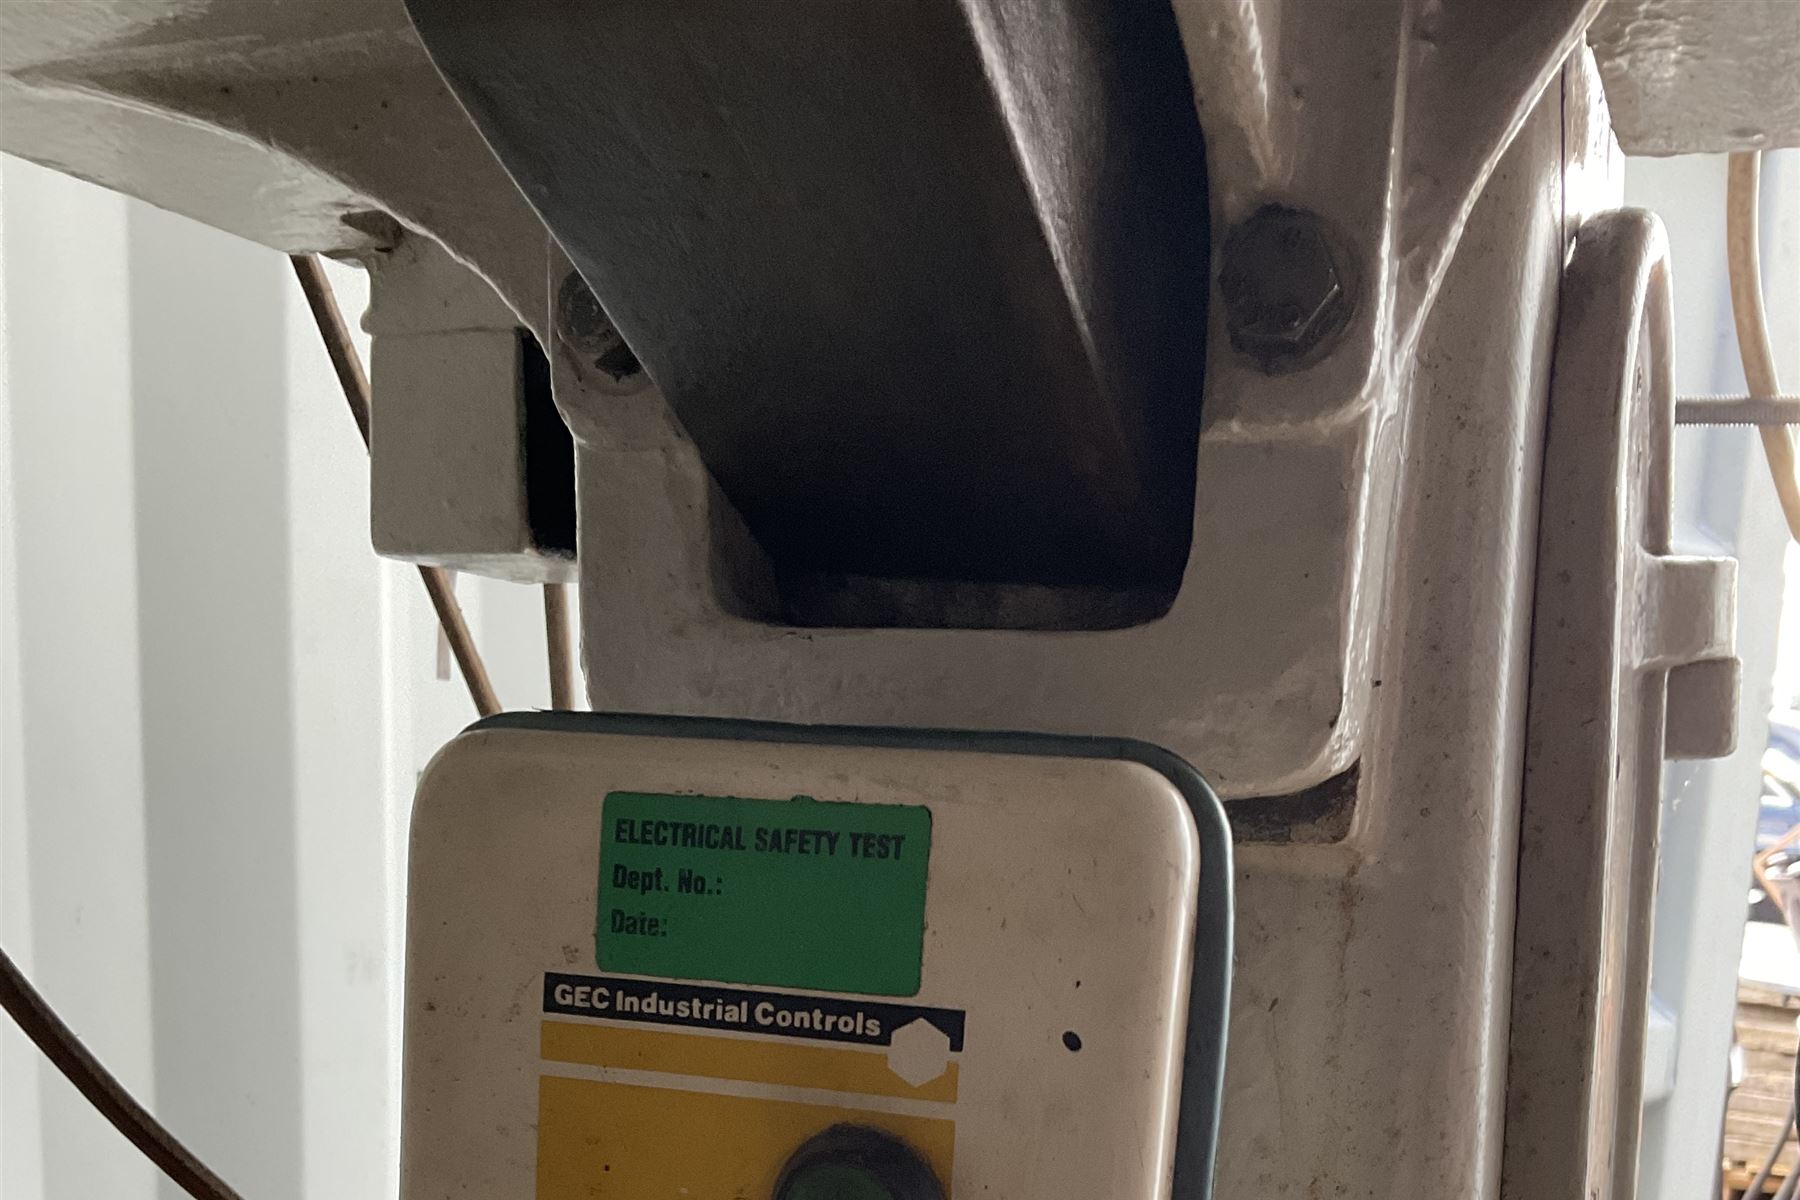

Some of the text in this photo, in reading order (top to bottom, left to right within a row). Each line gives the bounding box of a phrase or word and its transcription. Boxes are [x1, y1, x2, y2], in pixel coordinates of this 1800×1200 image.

[614, 818, 906, 860] ELECTRICAL SAFETY TEST
[612, 863, 723, 896] Dept. No.:
[610, 908, 667, 937] Date:
[554, 982, 881, 1037] GEC Industrial Controls
